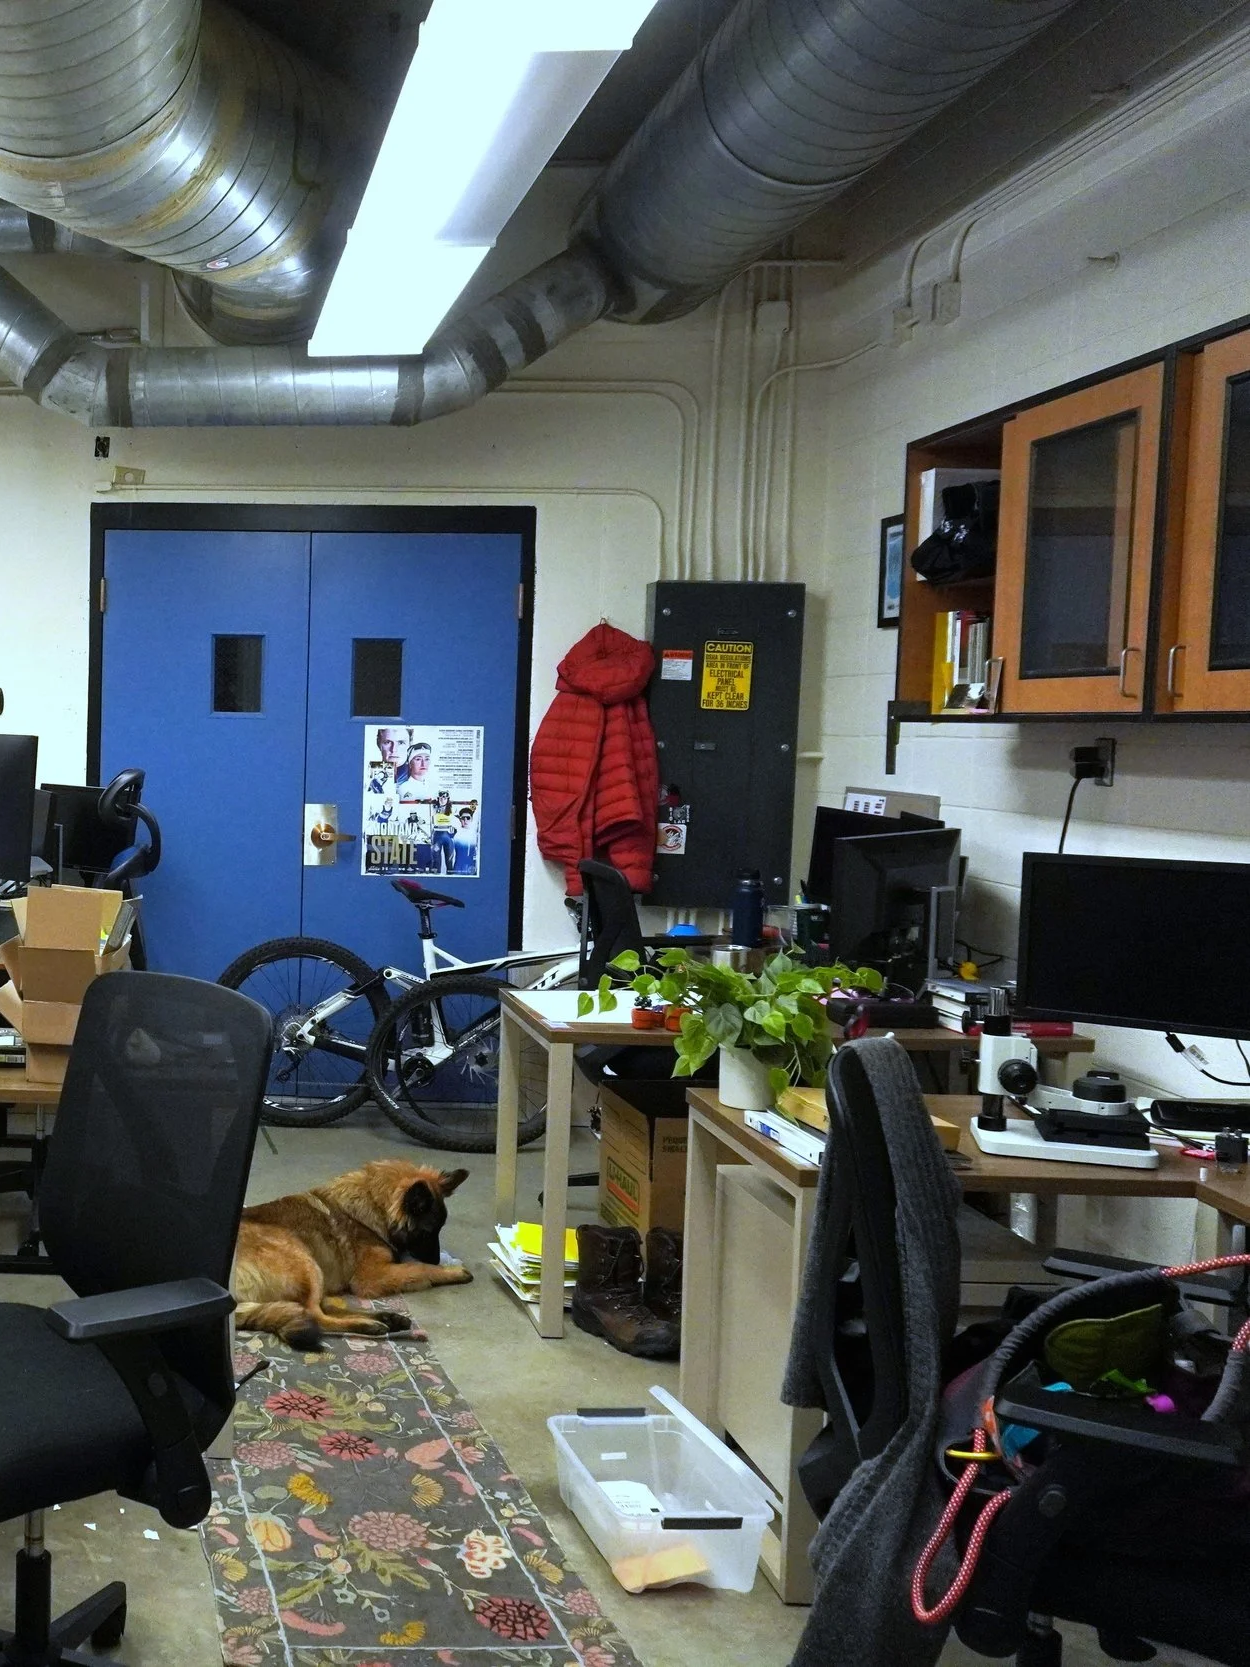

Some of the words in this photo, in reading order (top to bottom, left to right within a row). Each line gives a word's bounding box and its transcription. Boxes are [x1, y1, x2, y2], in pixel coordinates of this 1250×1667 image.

[707, 643, 751, 653] CAUTION
[709, 670, 744, 678] ELECTRICAL
[707, 692, 722, 700] KEPT
[725, 693, 744, 701] CLEAR
[703, 700, 713, 708] FOR
[716, 700, 724, 708] 36
[726, 700, 748, 709] INCHES
[368, 822, 418, 836] MONTANA
[371, 835, 418, 865] STATE
